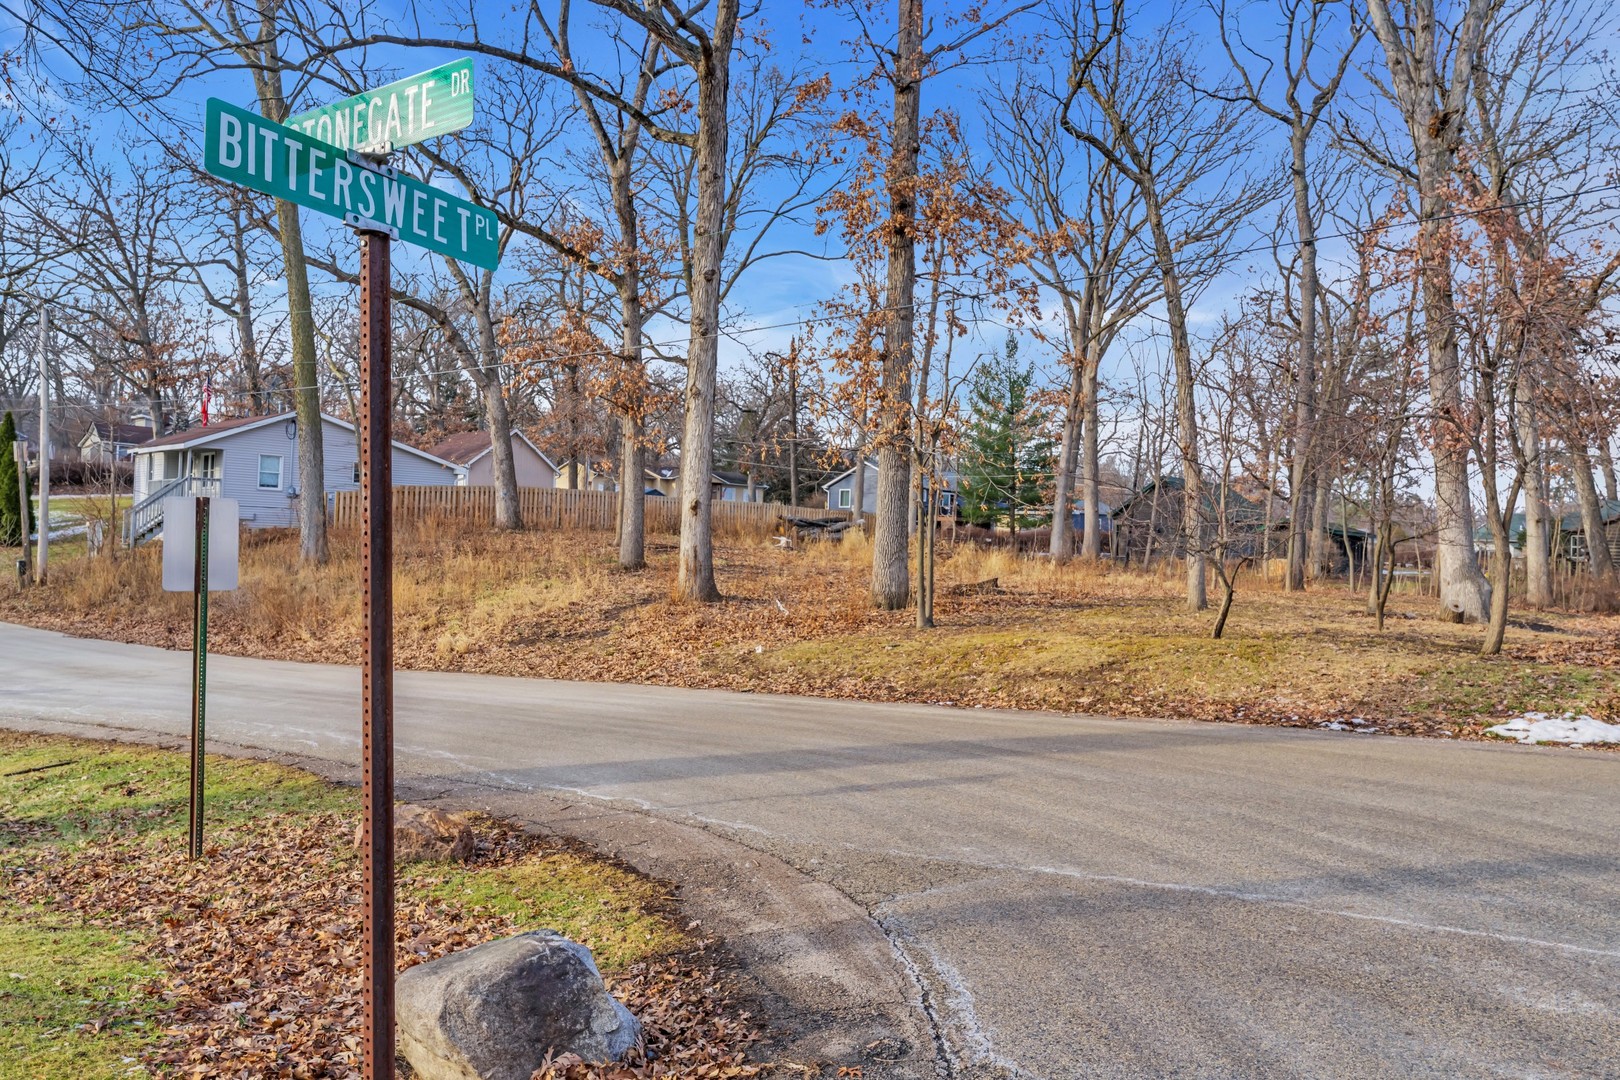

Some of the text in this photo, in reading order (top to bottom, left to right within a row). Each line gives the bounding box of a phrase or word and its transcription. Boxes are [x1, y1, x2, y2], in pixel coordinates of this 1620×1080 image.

[289, 68, 470, 151] TONEGATE DR
[219, 111, 493, 252] BITTERSWEET PL
